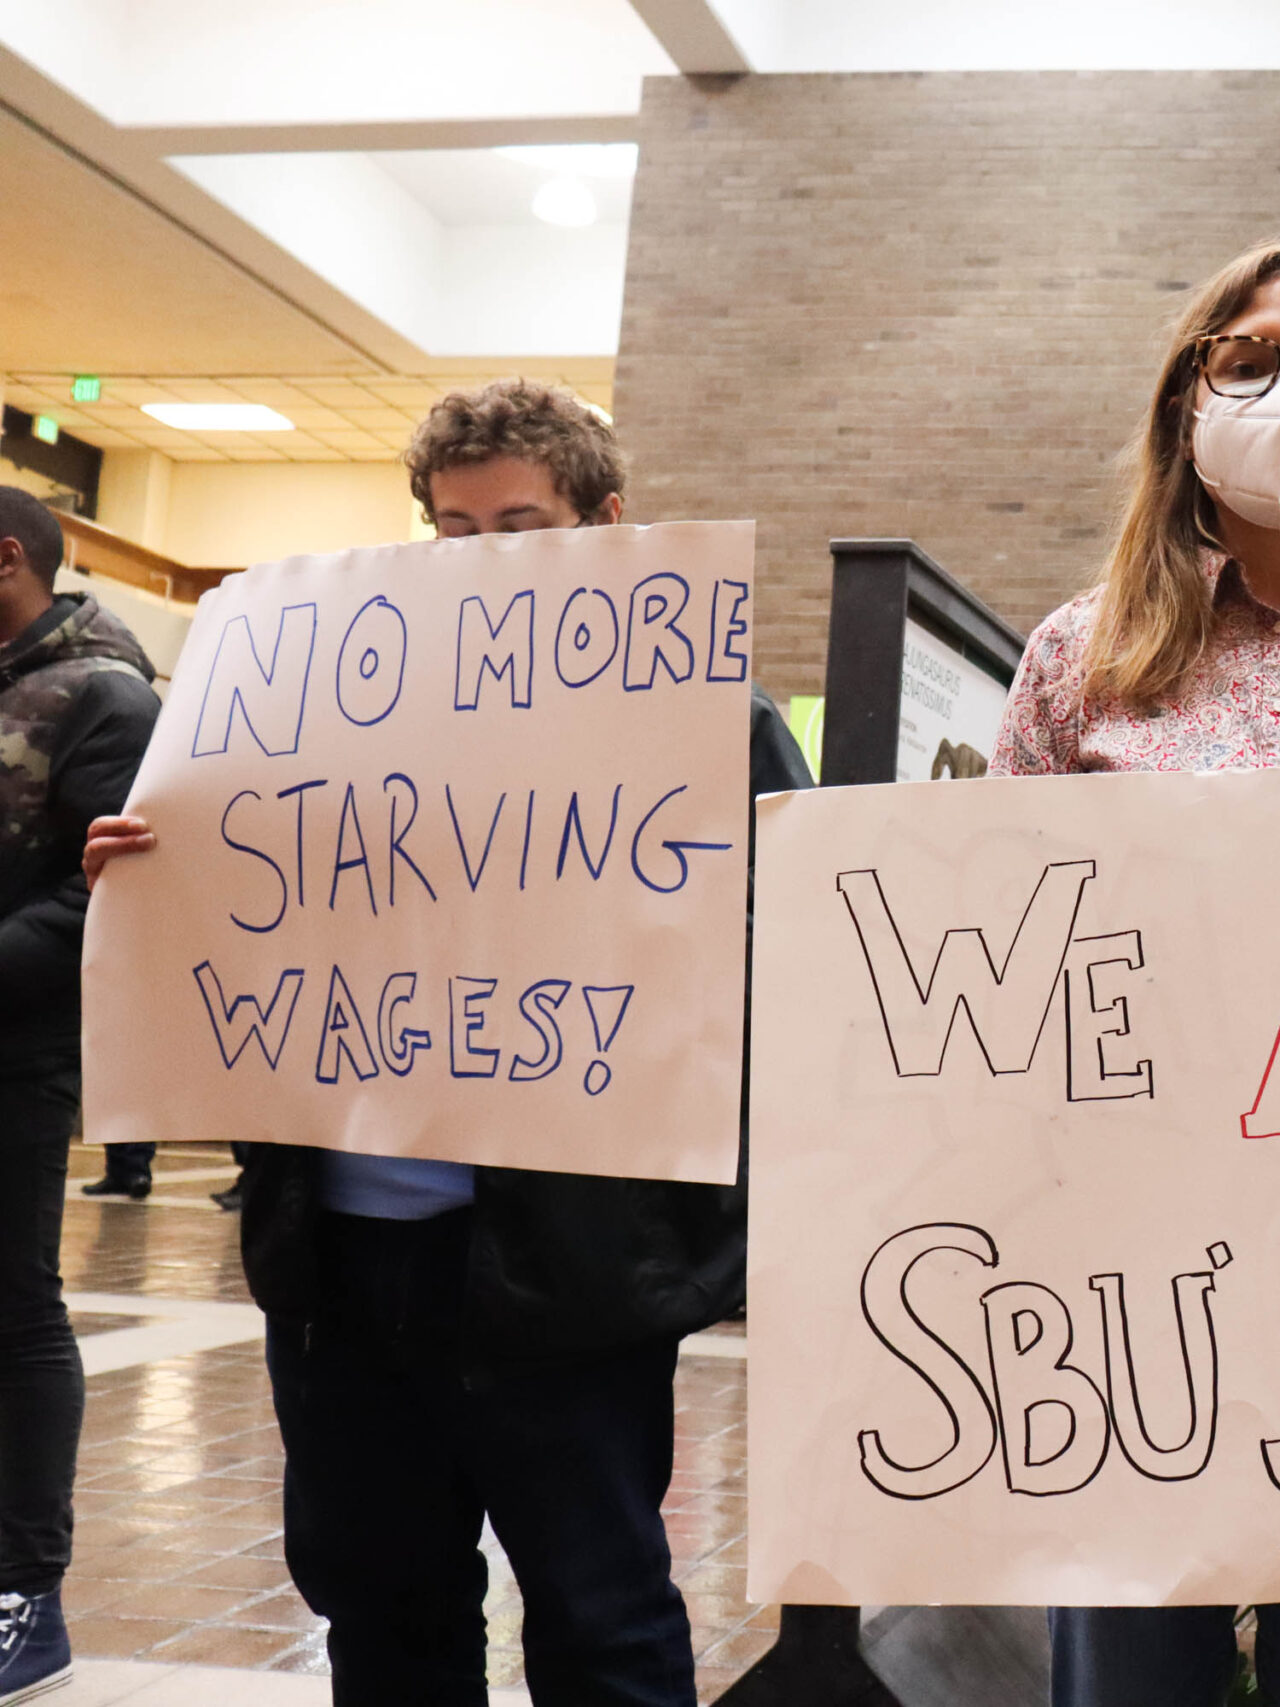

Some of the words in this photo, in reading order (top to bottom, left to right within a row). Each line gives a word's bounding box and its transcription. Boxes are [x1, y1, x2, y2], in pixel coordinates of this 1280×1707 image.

[191, 595, 408, 758] NO
[454, 572, 749, 711] MORE
[221, 772, 733, 932] STARVING
[192, 960, 635, 1096] WAGES!
[836, 859, 1155, 1103] WE
